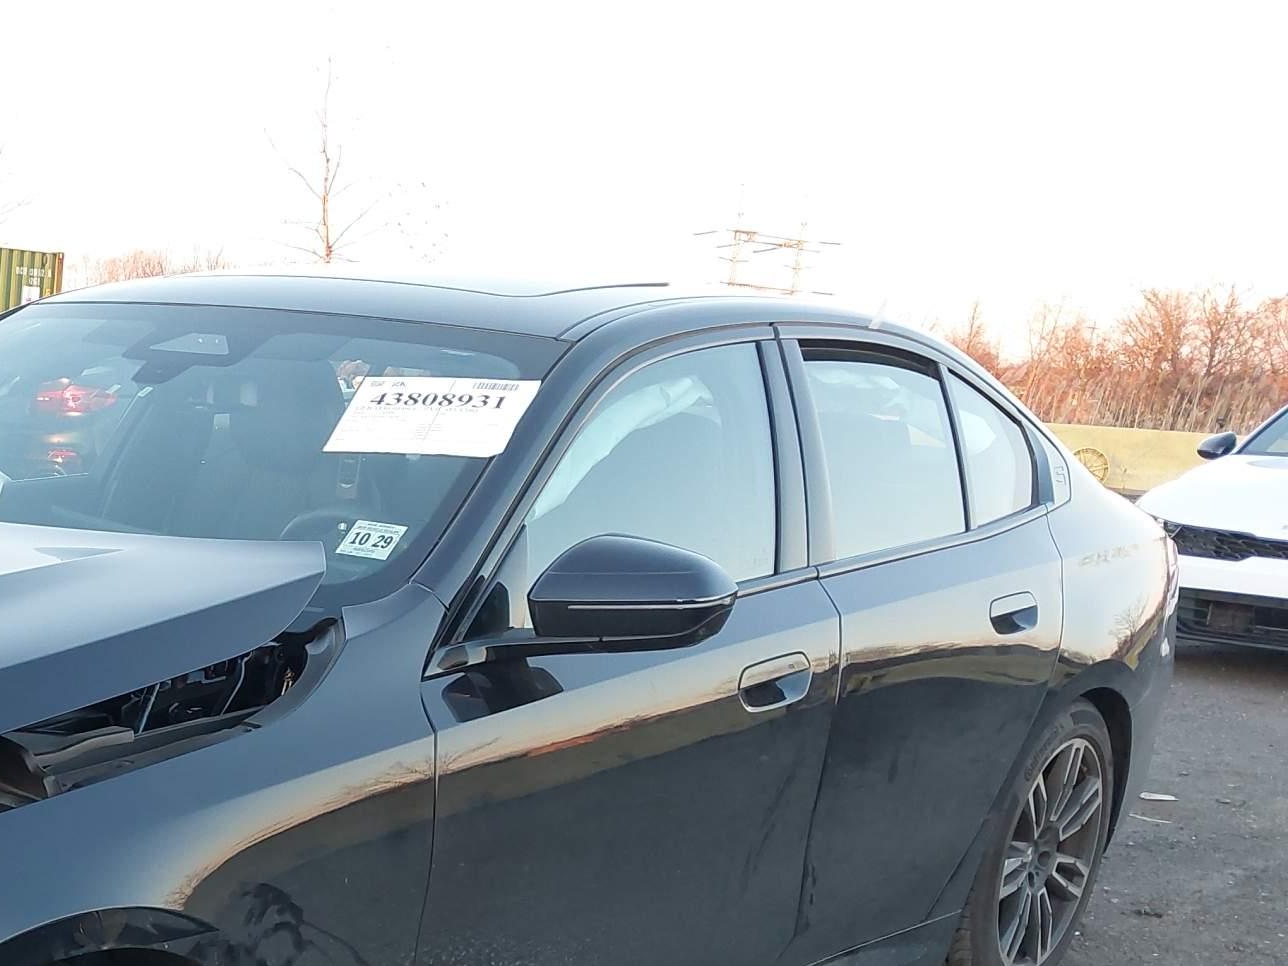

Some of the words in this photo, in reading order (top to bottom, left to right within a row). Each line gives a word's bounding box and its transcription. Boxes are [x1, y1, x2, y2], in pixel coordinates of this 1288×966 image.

[370, 392, 506, 409] 43808931
[349, 531, 371, 546] 10
[371, 534, 394, 549] 29
